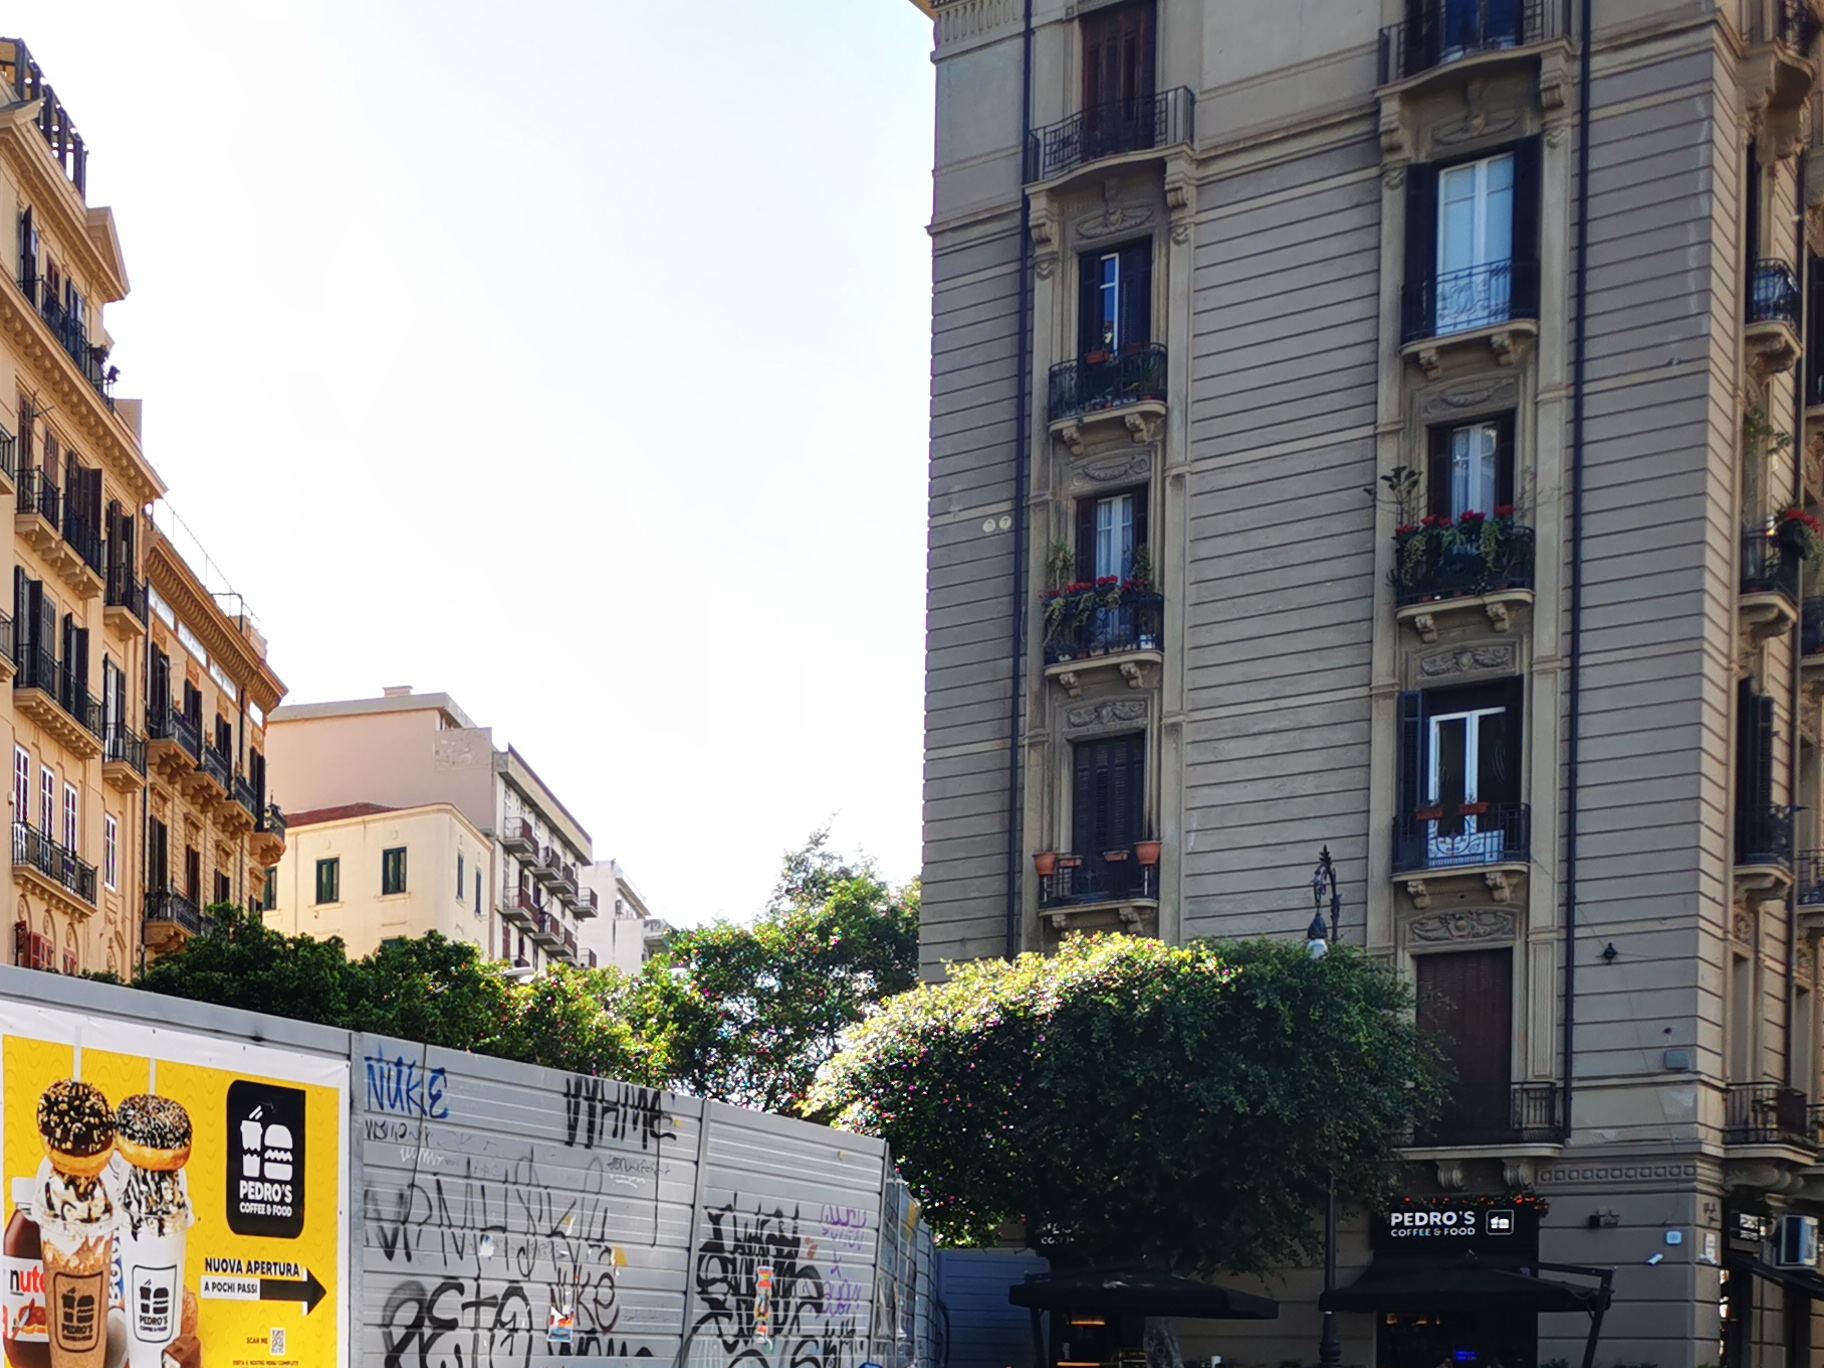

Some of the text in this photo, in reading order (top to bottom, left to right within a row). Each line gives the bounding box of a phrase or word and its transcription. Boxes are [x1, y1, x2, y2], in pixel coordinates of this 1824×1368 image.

[239, 1180, 293, 1203] PEDRO'S
[239, 1202, 266, 1215] COFFEE
[272, 1204, 293, 1217] FOOD
[1391, 1211, 1475, 1227] PEDRO'S
[1391, 1228, 1431, 1237] COFFEE
[1444, 1227, 1475, 1236] FOOD
[205, 1257, 300, 1277] NUOVA APERTURA
[204, 1281, 258, 1294] A POCHI PASSI
[139, 1315, 168, 1326] PEDRO'S
